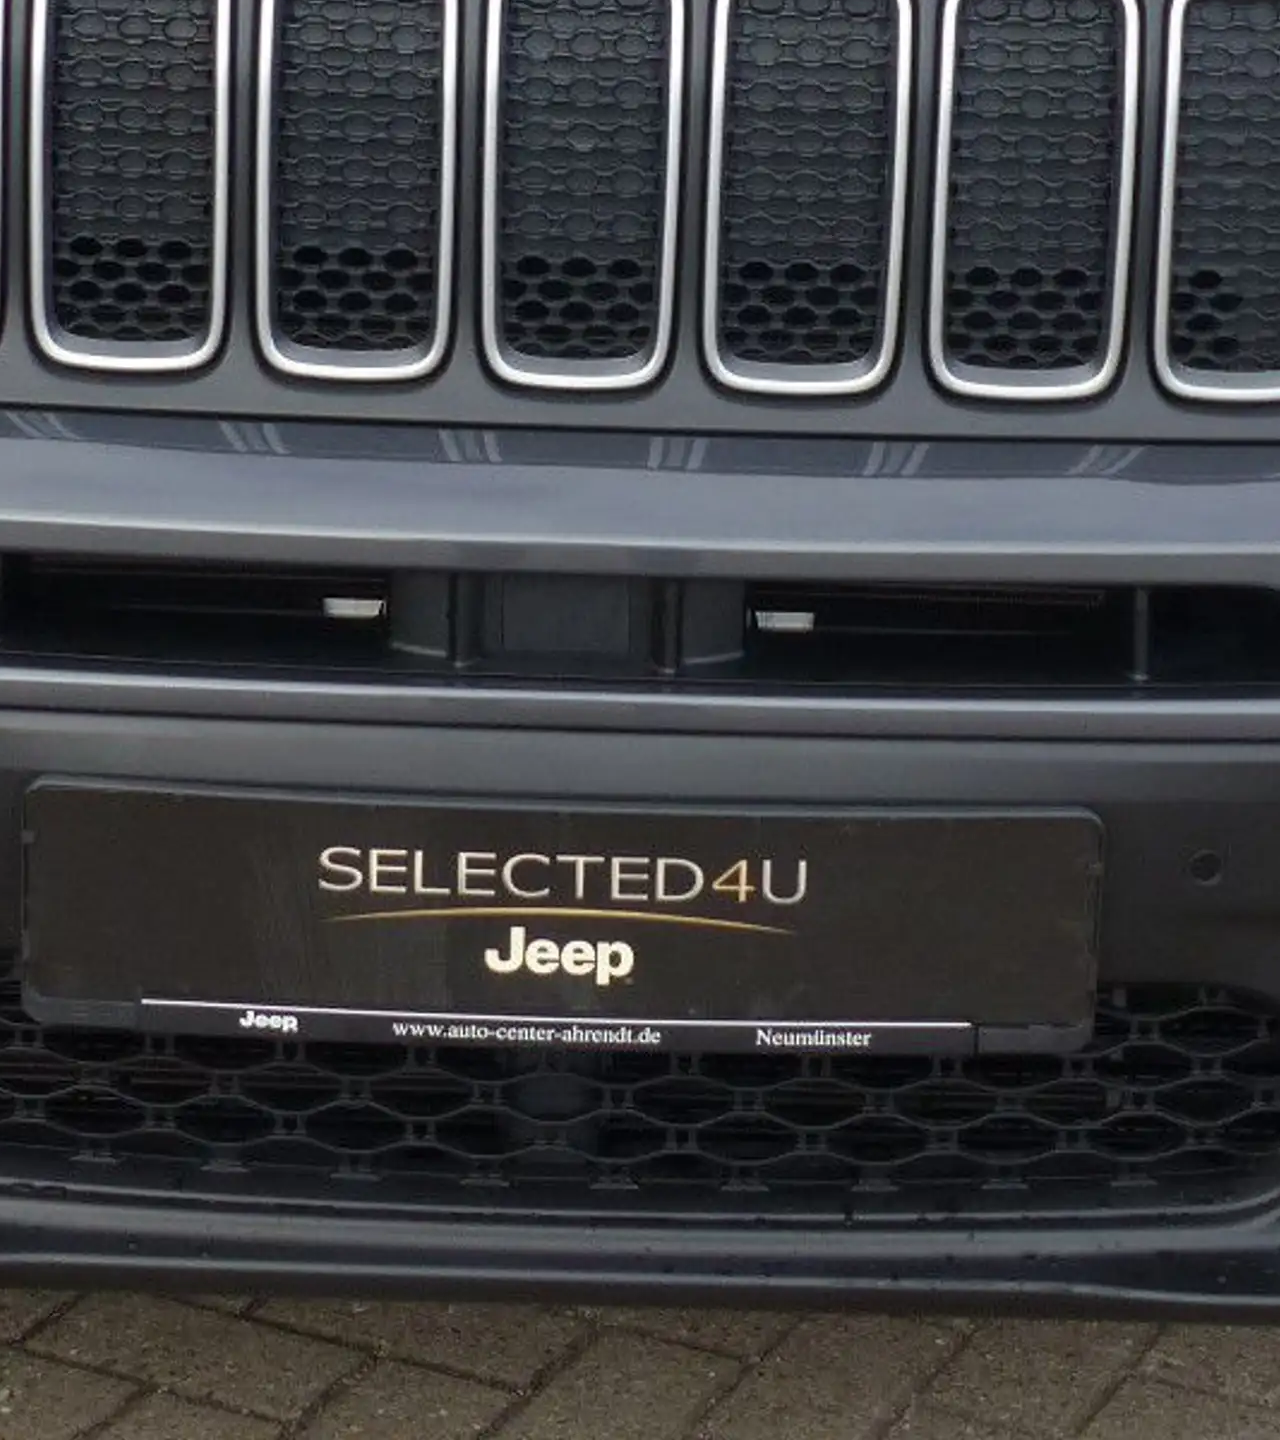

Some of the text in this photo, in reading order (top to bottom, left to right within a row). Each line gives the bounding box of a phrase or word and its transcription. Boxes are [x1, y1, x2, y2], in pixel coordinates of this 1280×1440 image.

[318, 846, 808, 905] SELECTED4U
[484, 926, 635, 986] Jeep
[239, 1010, 872, 1048] Jeep www.auto-center-ahrendt.de Neumünster
